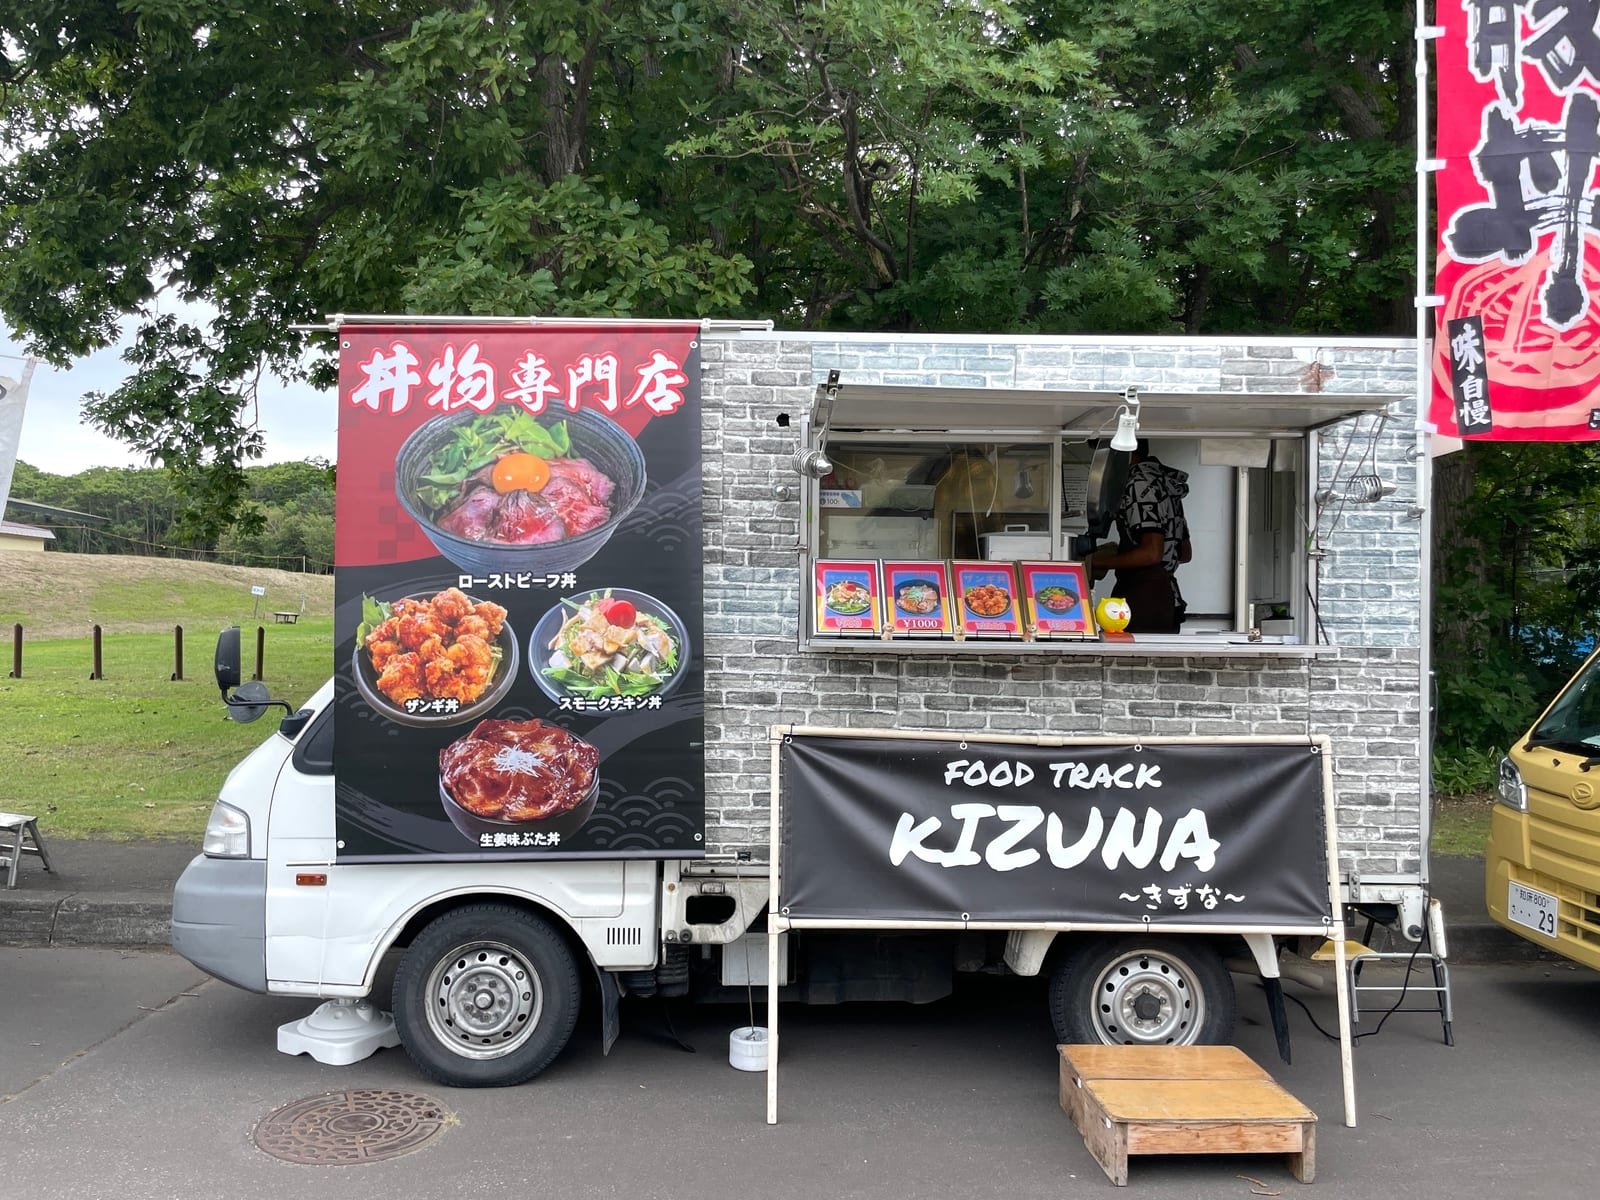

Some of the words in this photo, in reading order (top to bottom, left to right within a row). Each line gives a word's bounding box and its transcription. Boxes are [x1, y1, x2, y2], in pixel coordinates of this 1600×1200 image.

[351, 341, 686, 414] 丼物専門店
[1451, 322, 1491, 427] 味自慢
[458, 573, 577, 589] ローストビーフ丼
[903, 619, 938, 628] ¥1000
[405, 698, 459, 713] ザンギ丼
[559, 696, 662, 710] スモークチキン丼
[944, 759, 1034, 787] FOOD
[1048, 761, 1163, 790] TRACK
[480, 832, 560, 847] 生姜味ぶた丼
[888, 803, 1221, 872] KIZUNA
[1538, 909, 1554, 934] 29
